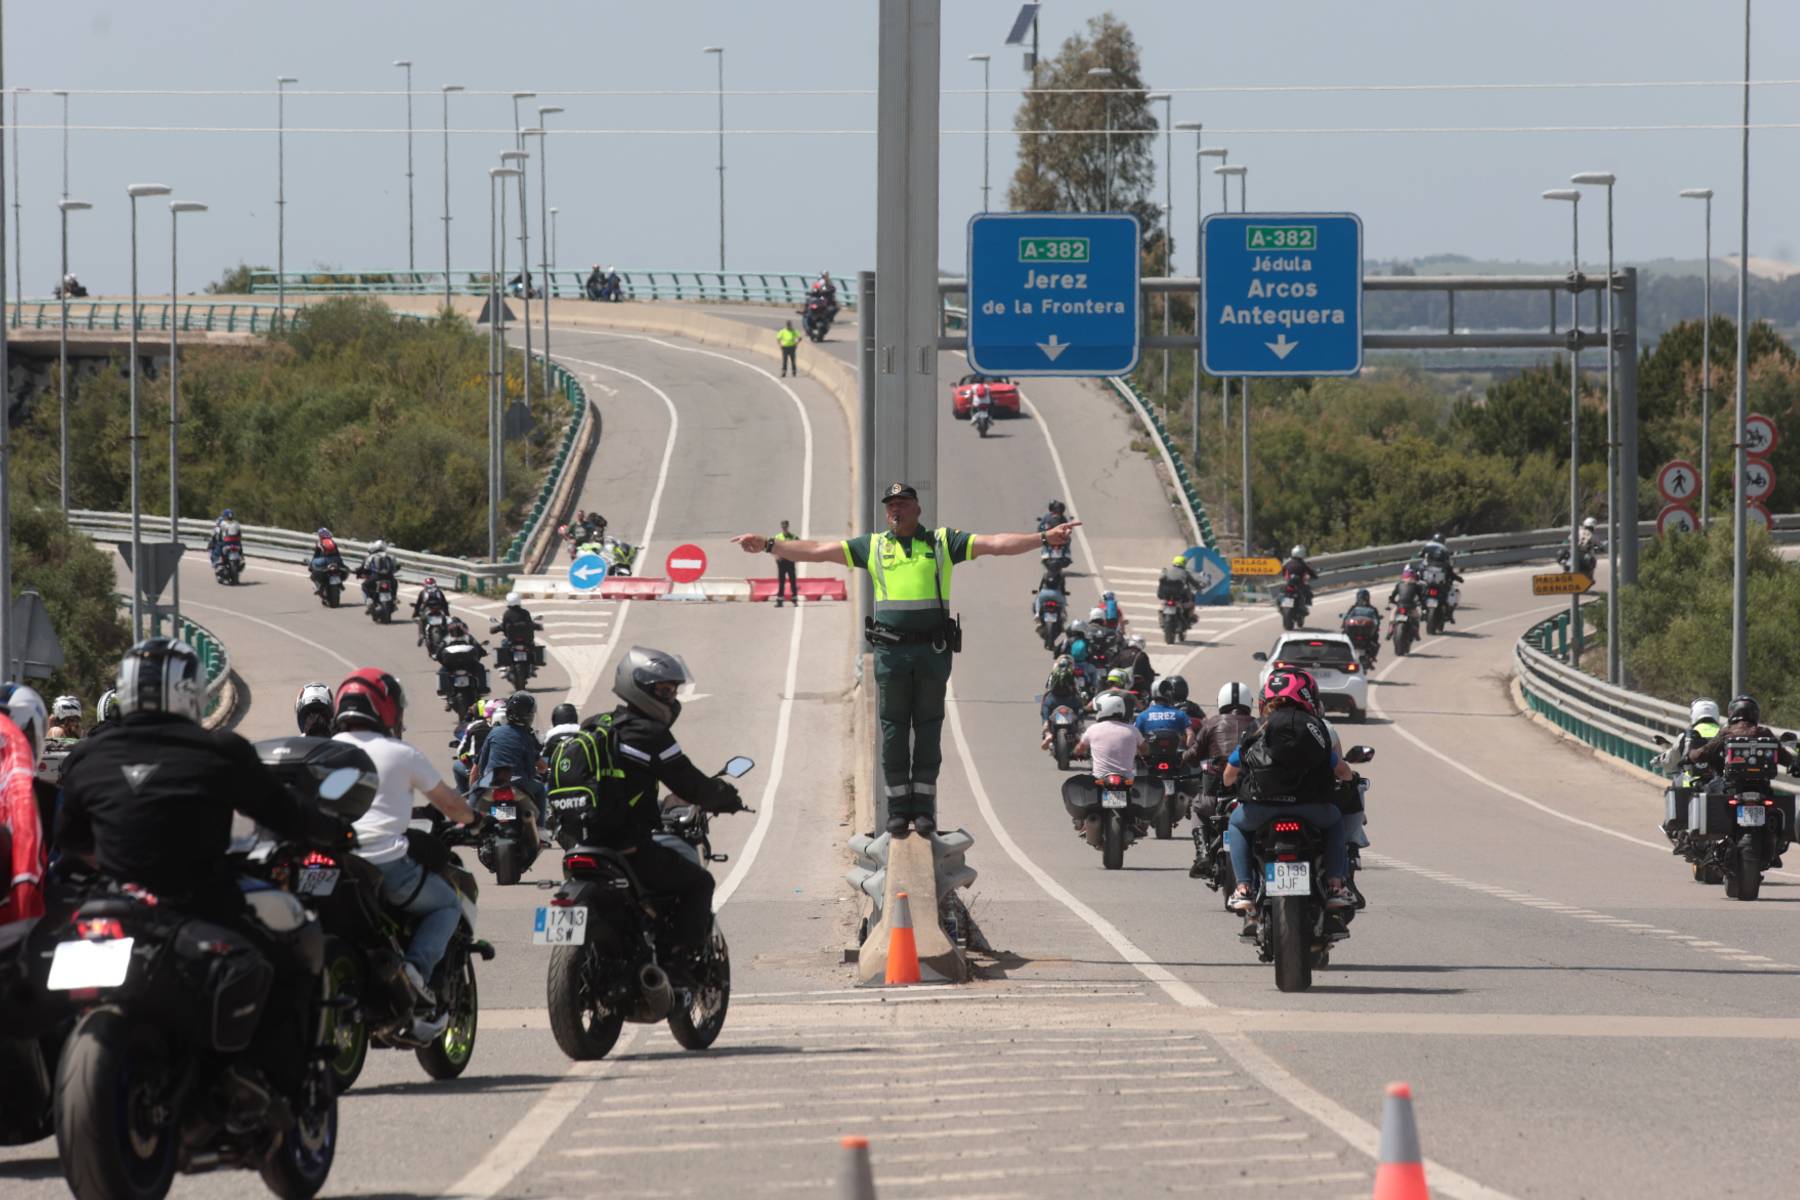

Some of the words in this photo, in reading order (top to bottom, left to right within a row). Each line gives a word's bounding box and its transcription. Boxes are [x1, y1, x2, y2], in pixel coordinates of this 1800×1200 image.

[1251, 230, 1312, 246] A-382
[1024, 242, 1085, 258] A-382
[1252, 256, 1312, 272] Jédula
[1023, 269, 1088, 289] Jerez
[1247, 279, 1318, 298] Arcos
[982, 299, 1006, 314] de
[1014, 300, 1033, 314] la
[1042, 299, 1125, 314] Frontera
[1219, 304, 1345, 328] Antequera
[1148, 711, 1176, 721] JEREZ
[550, 910, 585, 926] 1713
[545, 927, 574, 943] LSW
